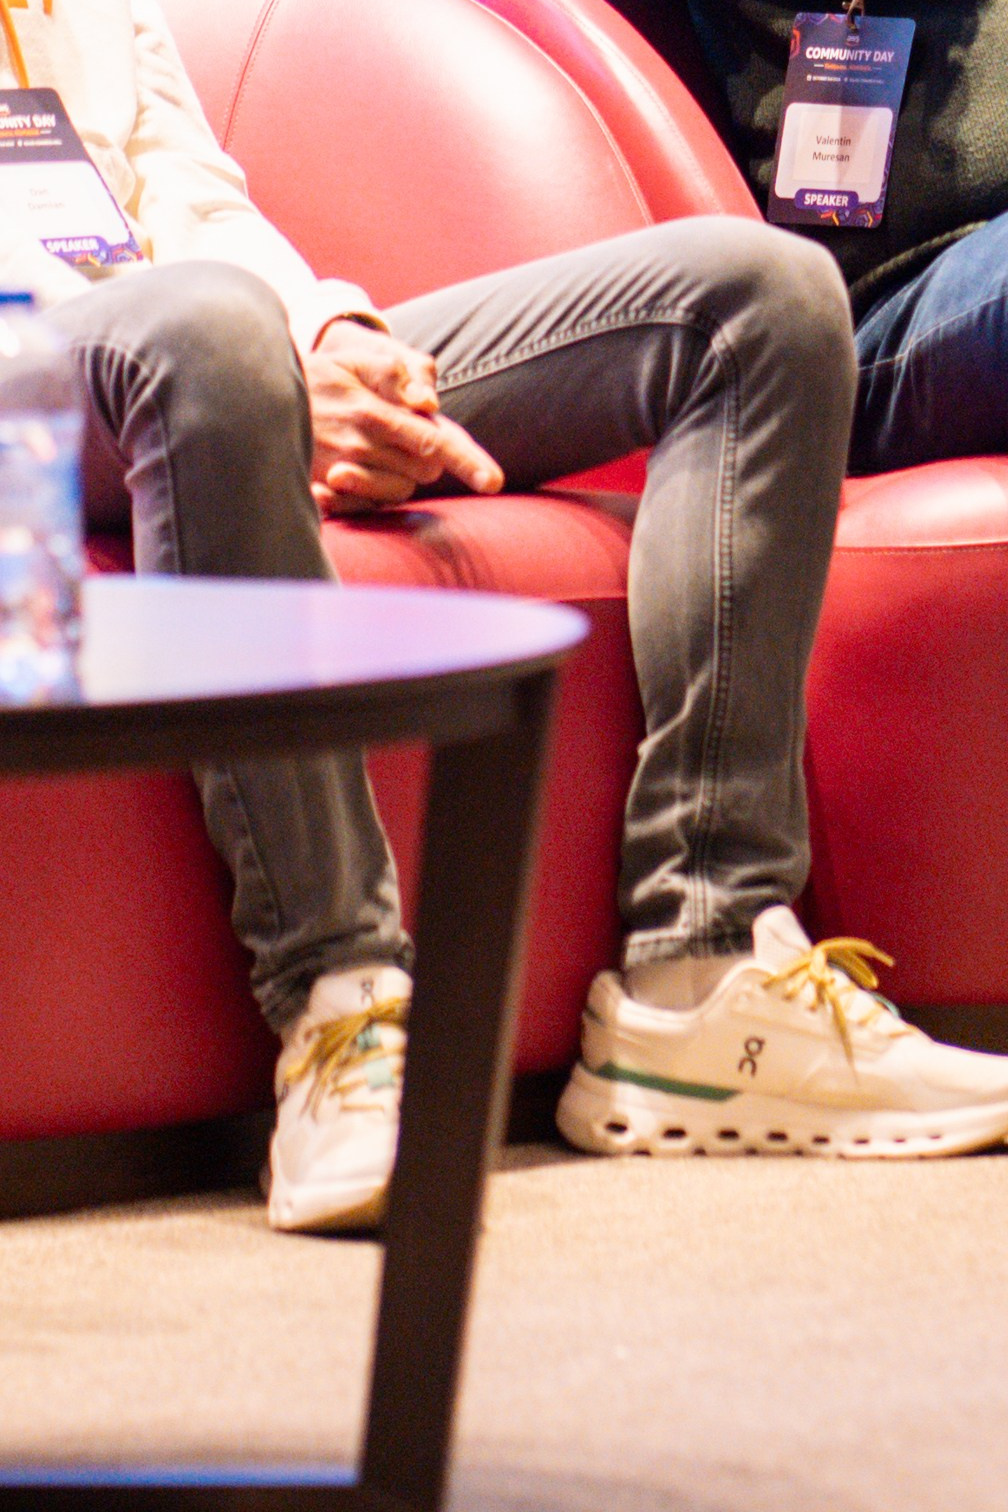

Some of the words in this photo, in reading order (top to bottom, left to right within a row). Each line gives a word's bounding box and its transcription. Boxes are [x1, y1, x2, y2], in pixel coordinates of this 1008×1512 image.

[805, 46, 872, 62] COMMUNITY
[873, 50, 895, 63] DAY
[816, 135, 852, 146] Valentin
[812, 151, 850, 162] Muresan
[803, 192, 849, 207] SPEAKER
[46, 238, 99, 253] SPEAKER
